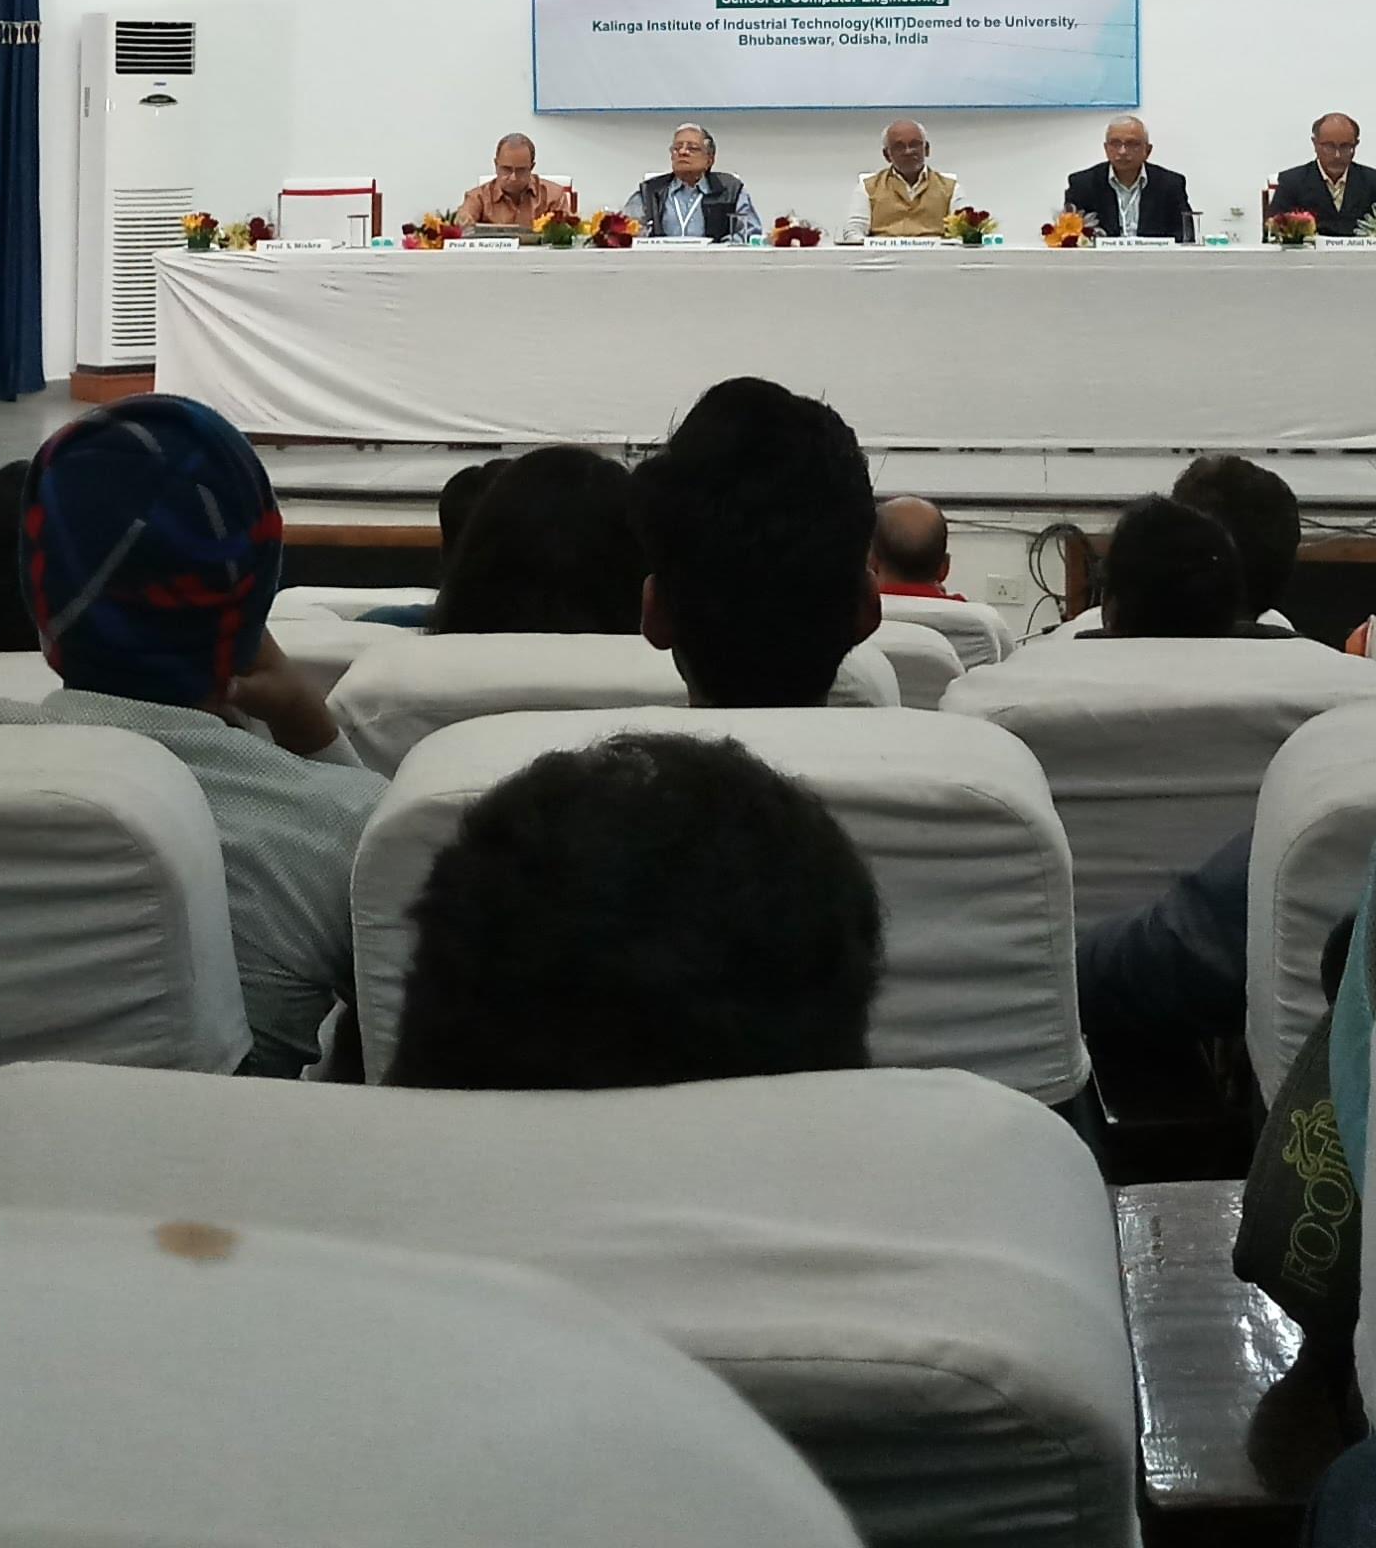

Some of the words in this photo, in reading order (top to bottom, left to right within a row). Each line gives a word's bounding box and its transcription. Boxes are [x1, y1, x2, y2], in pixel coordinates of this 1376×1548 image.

[592, 19, 643, 34] Kalinga
[647, 19, 702, 31] Institute
[706, 18, 720, 30] of
[723, 18, 787, 30] Industrial
[966, 17, 980, 27] to
[983, 16, 1001, 27] be
[1004, 15, 1078, 30] University,
[738, 33, 835, 47] Bhubaneswar,
[838, 32, 891, 46] Odisha,
[895, 32, 929, 45] India
